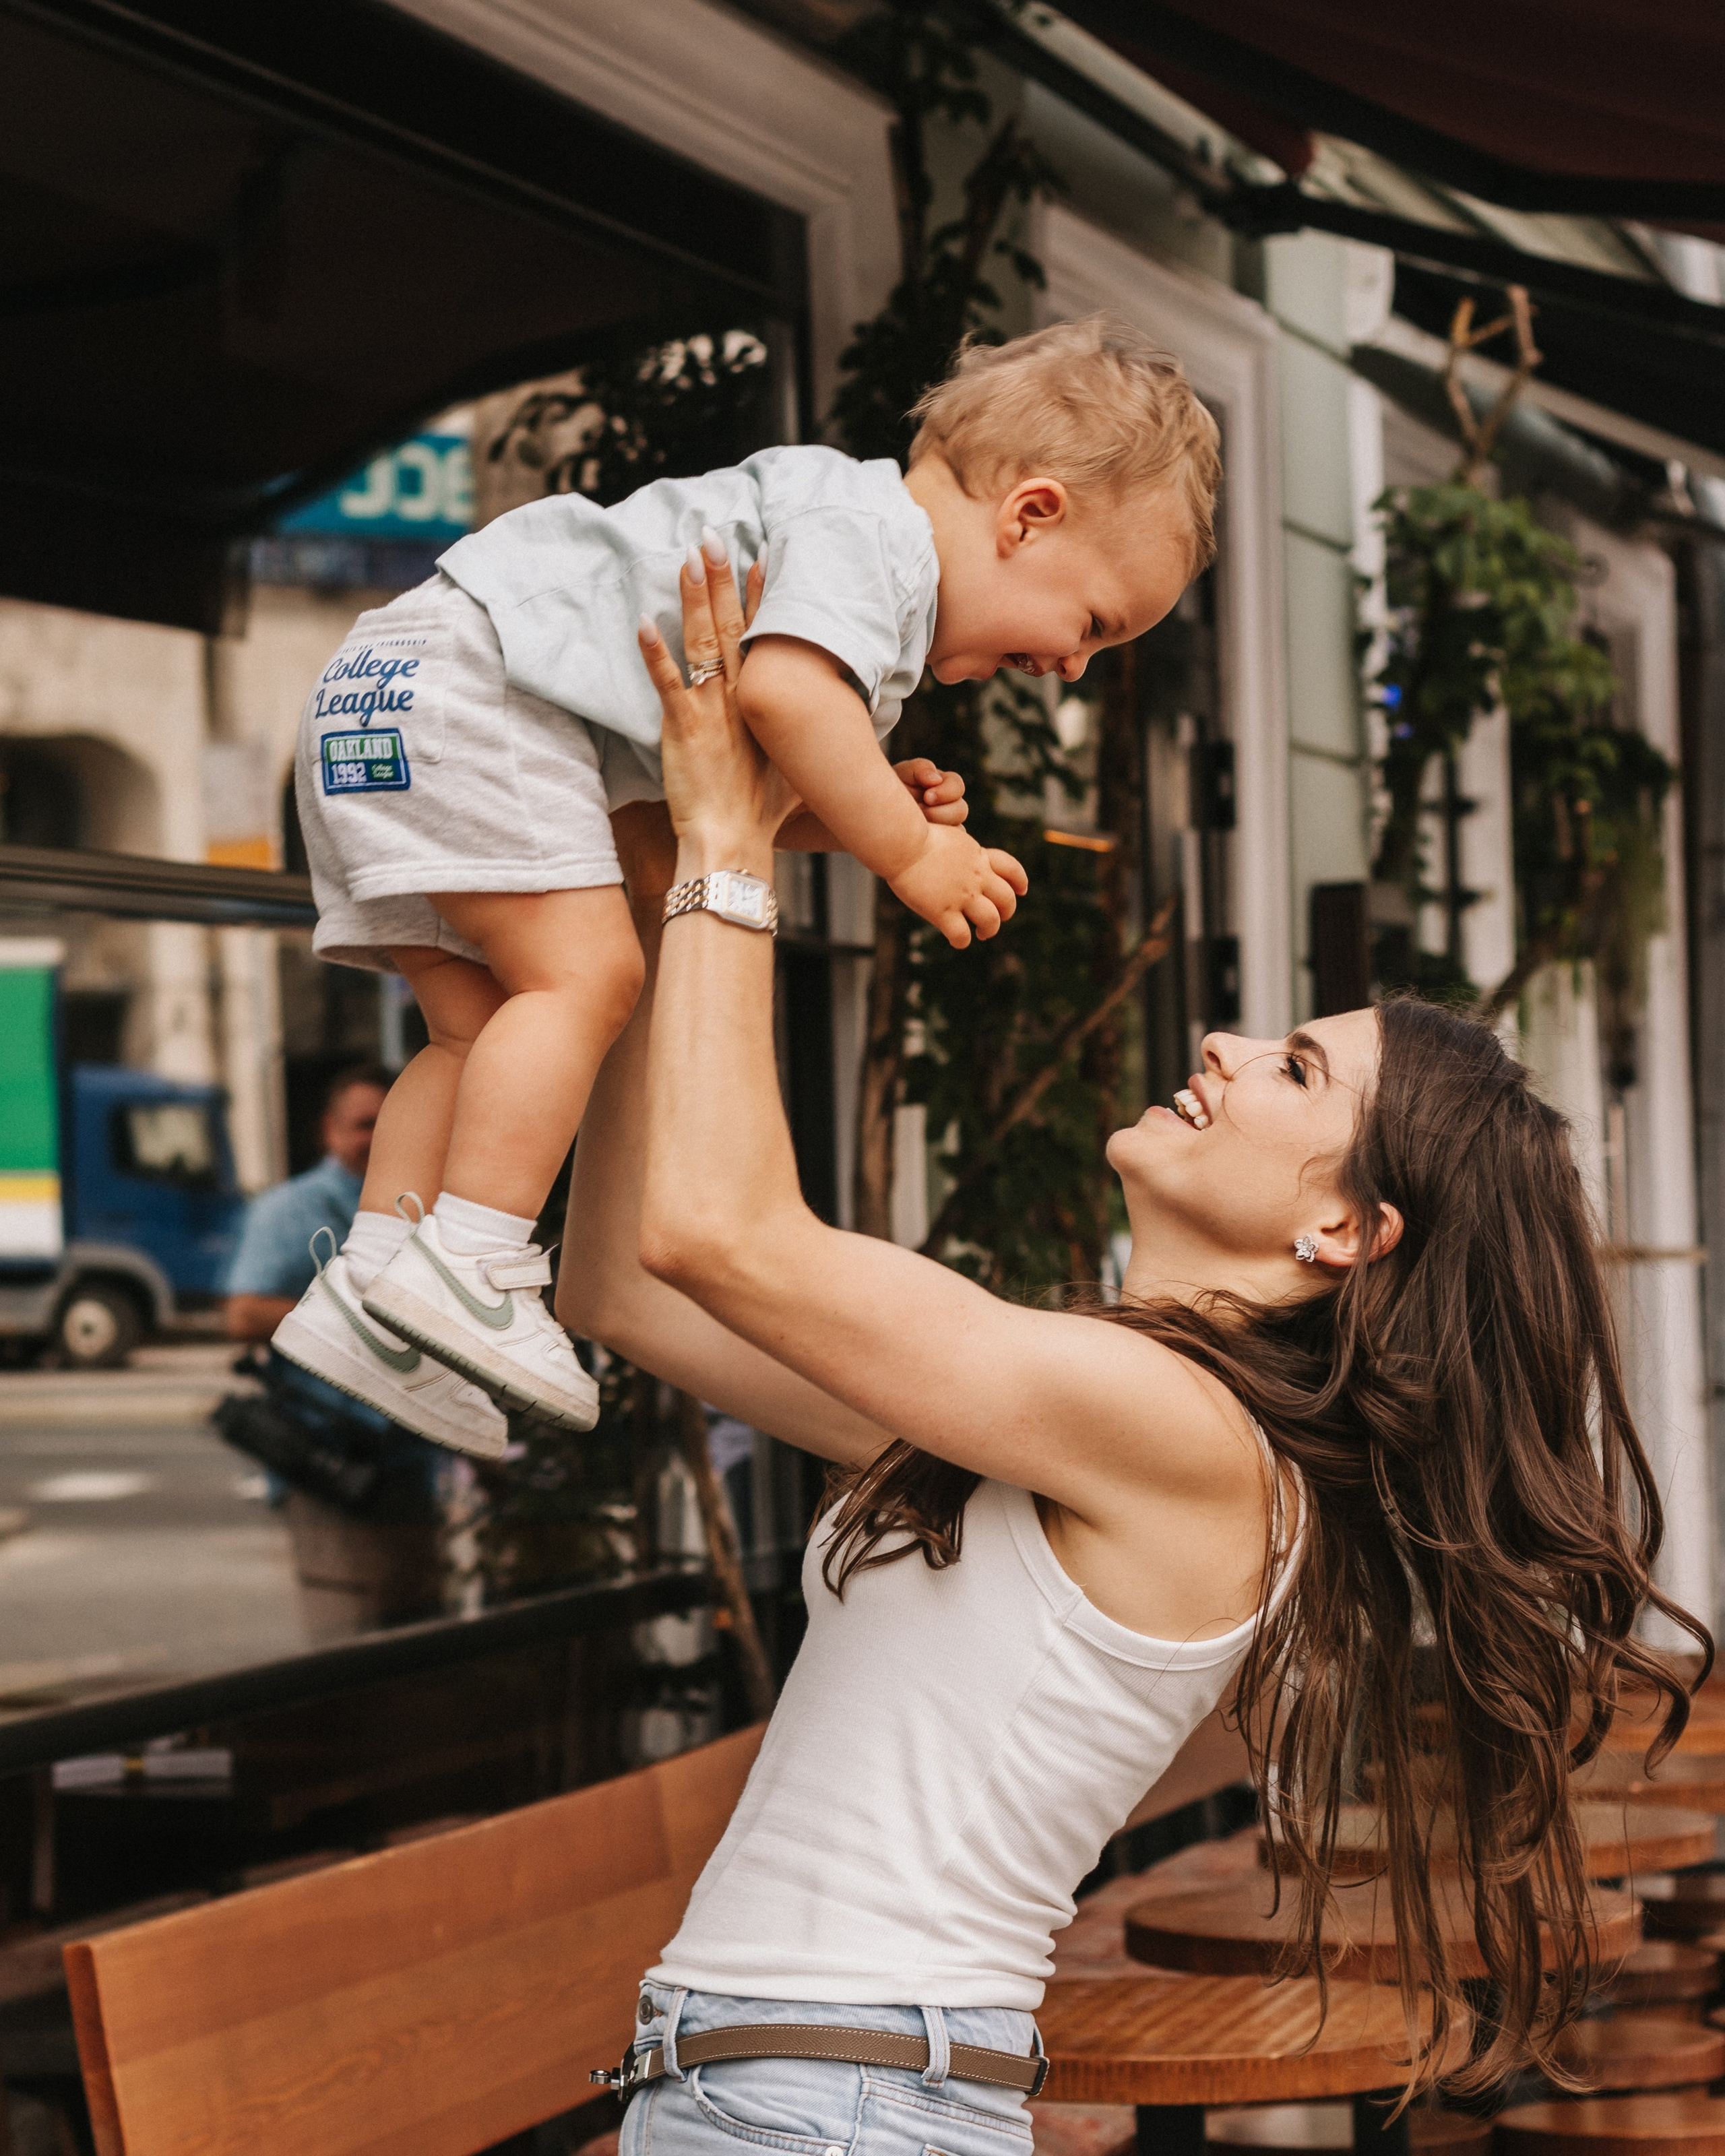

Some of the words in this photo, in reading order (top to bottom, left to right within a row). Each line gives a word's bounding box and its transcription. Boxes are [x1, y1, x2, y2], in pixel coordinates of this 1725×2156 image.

[323, 649, 420, 689] College
[315, 689, 414, 727] League
[330, 737, 393, 761] OAKLAND
[332, 762, 367, 784] 1992
